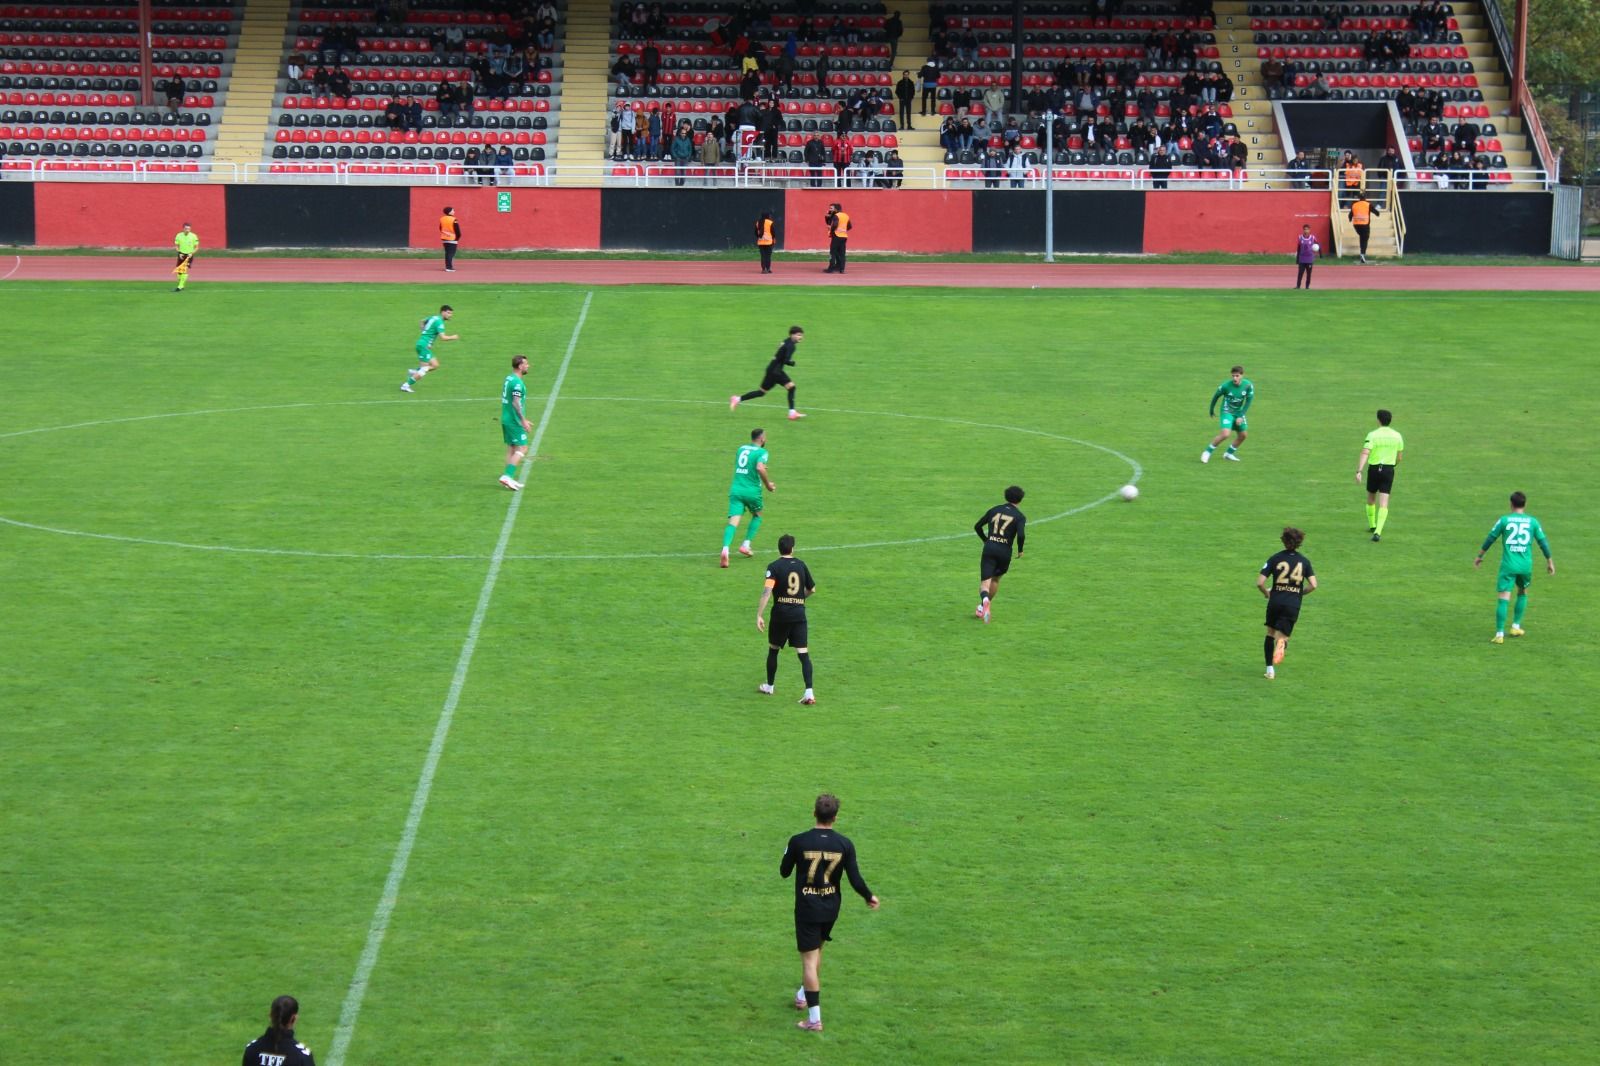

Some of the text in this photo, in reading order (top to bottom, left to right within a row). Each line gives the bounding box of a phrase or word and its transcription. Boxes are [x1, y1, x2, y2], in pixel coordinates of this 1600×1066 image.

[738, 450, 750, 468] 6
[991, 512, 1014, 536] 17
[1505, 522, 1530, 545] 25
[787, 571, 800, 596] 9
[1276, 561, 1303, 585] 24
[803, 850, 842, 884] 77
[258, 1052, 286, 1066] TFF
